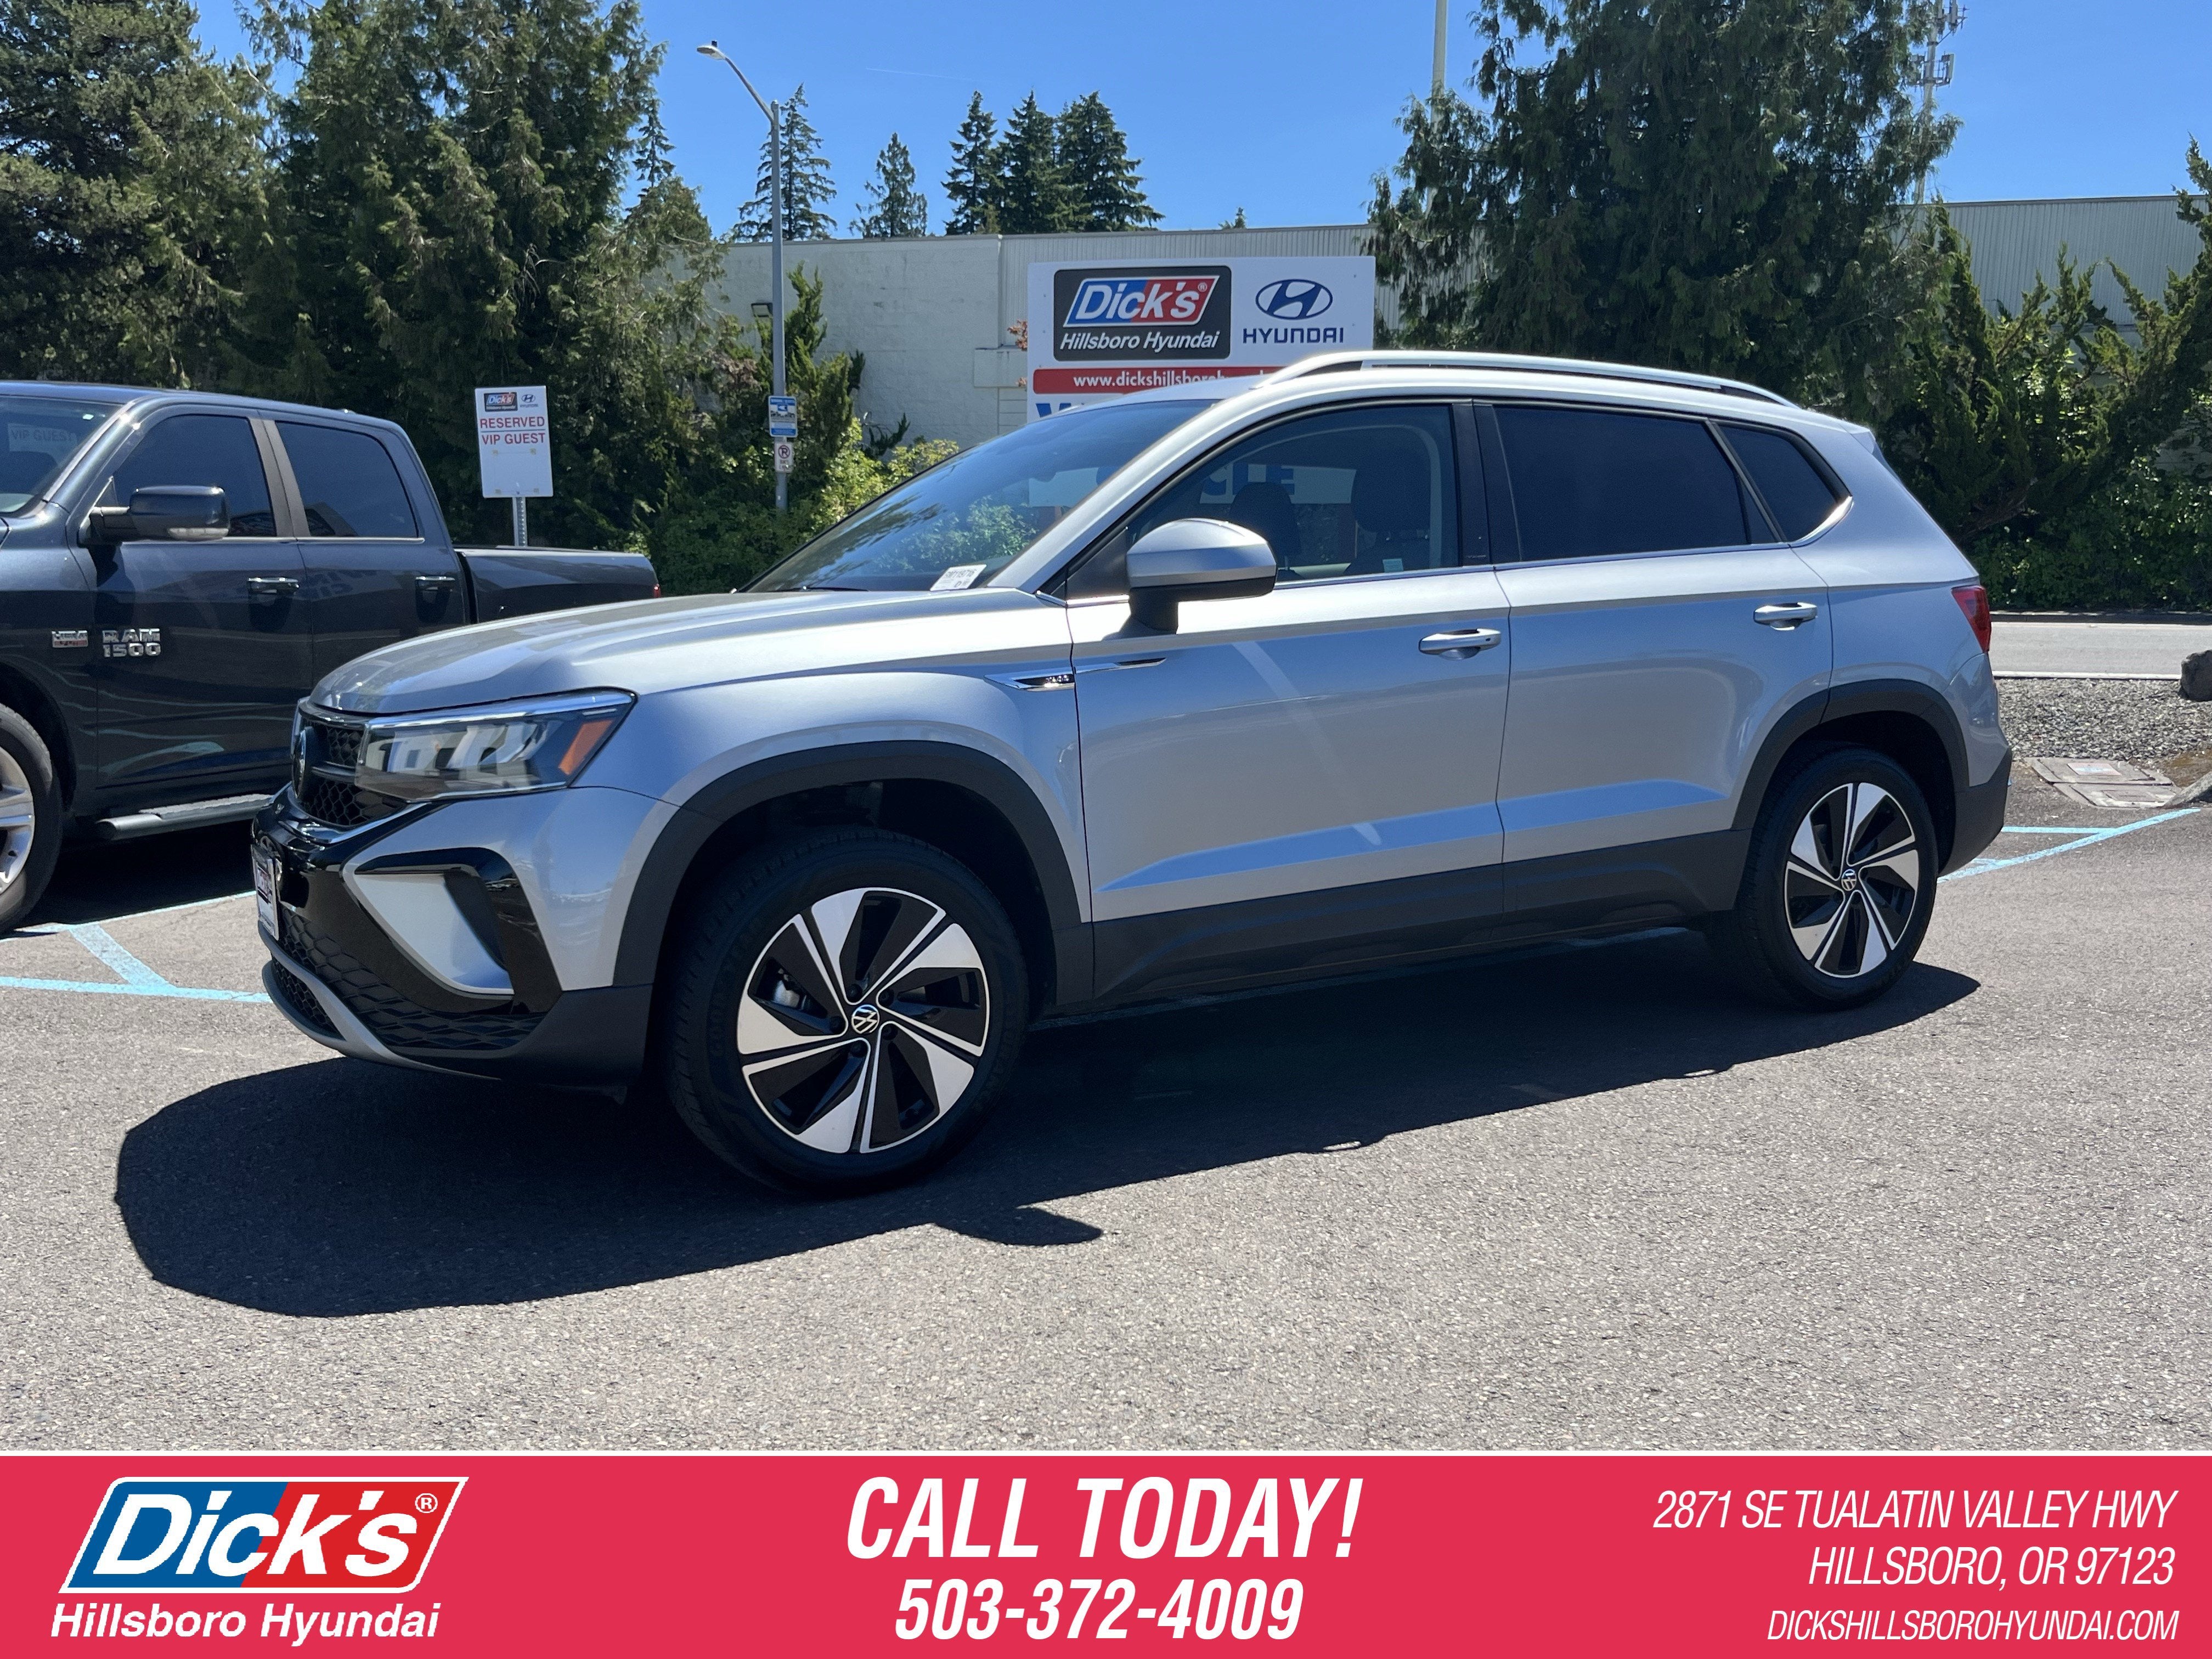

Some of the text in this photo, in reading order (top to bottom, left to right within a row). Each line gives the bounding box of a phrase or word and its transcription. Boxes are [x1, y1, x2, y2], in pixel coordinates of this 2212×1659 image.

[1060, 330, 1221, 353] Hillsboro Hyundai
[1243, 328, 1344, 344] HYUNDAI
[480, 416, 545, 429] RESERVED
[482, 432, 546, 445] VIP GUEST
[102, 628, 160, 643] RAM
[103, 642, 161, 657] 1500
